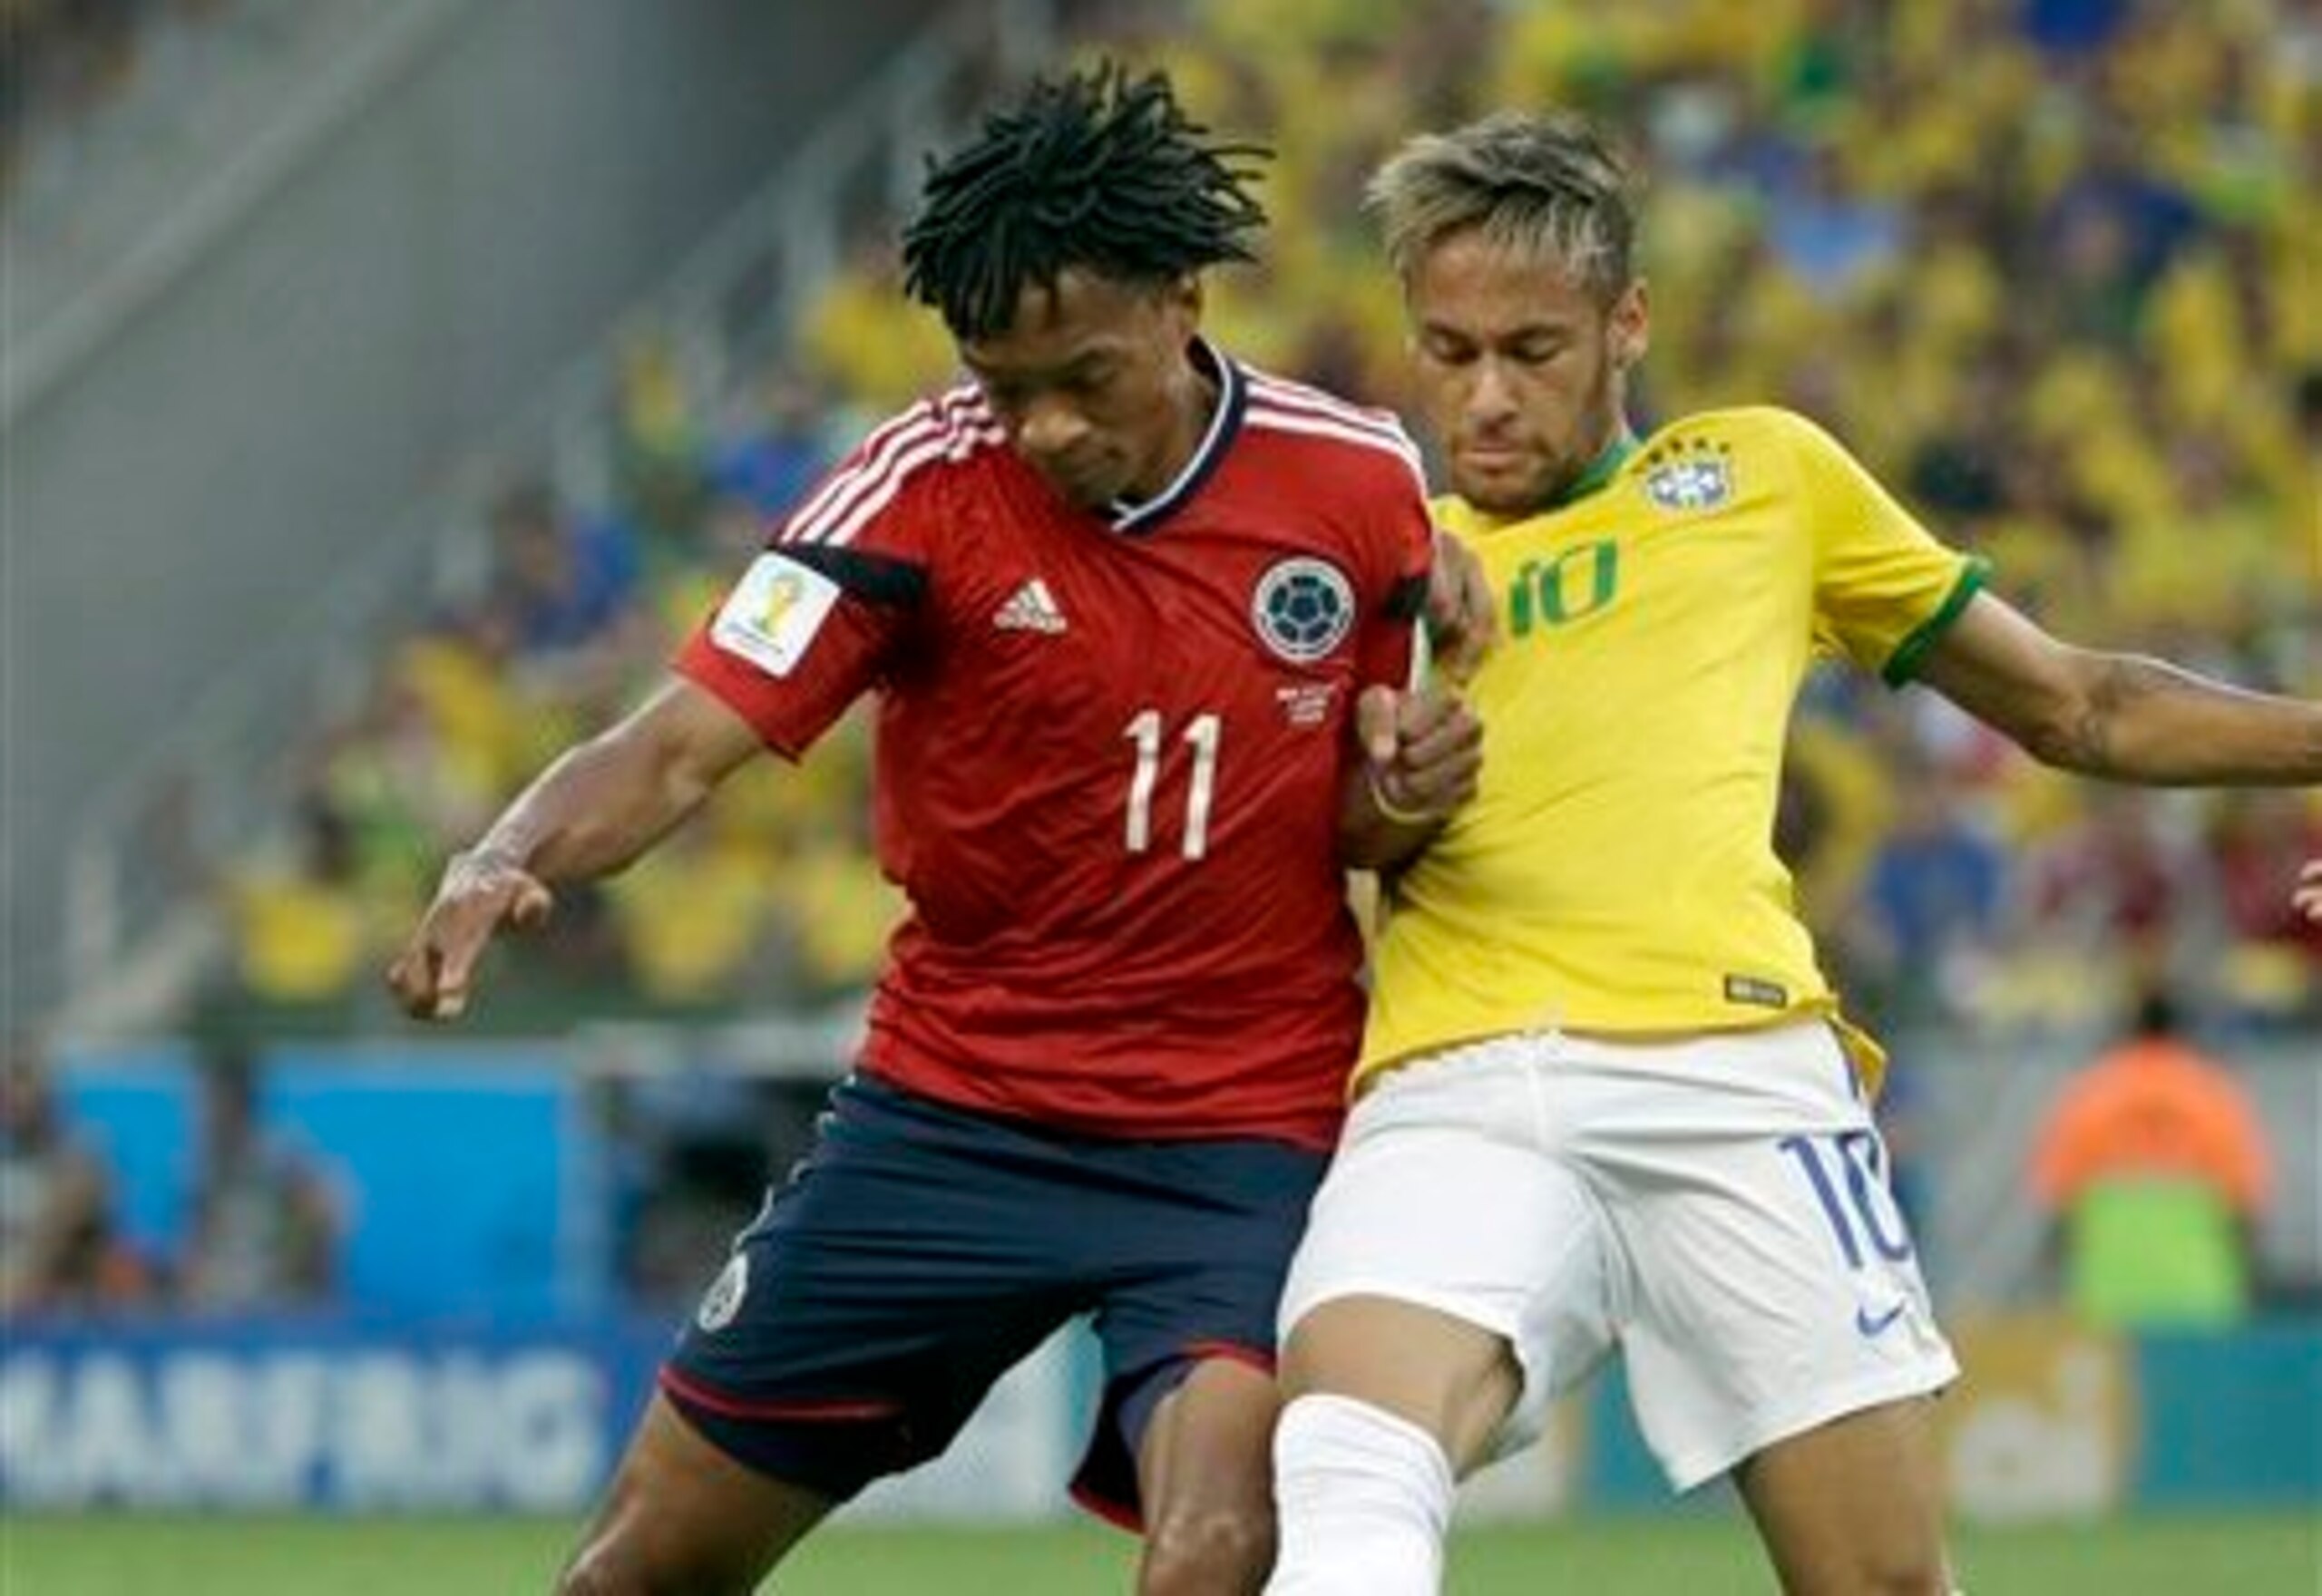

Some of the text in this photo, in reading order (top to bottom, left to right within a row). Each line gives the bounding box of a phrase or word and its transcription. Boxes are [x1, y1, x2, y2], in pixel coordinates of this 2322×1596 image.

[1510, 540, 1617, 638] 10
[1124, 709, 1221, 861] 11
[1778, 1130, 1910, 1268] 10
